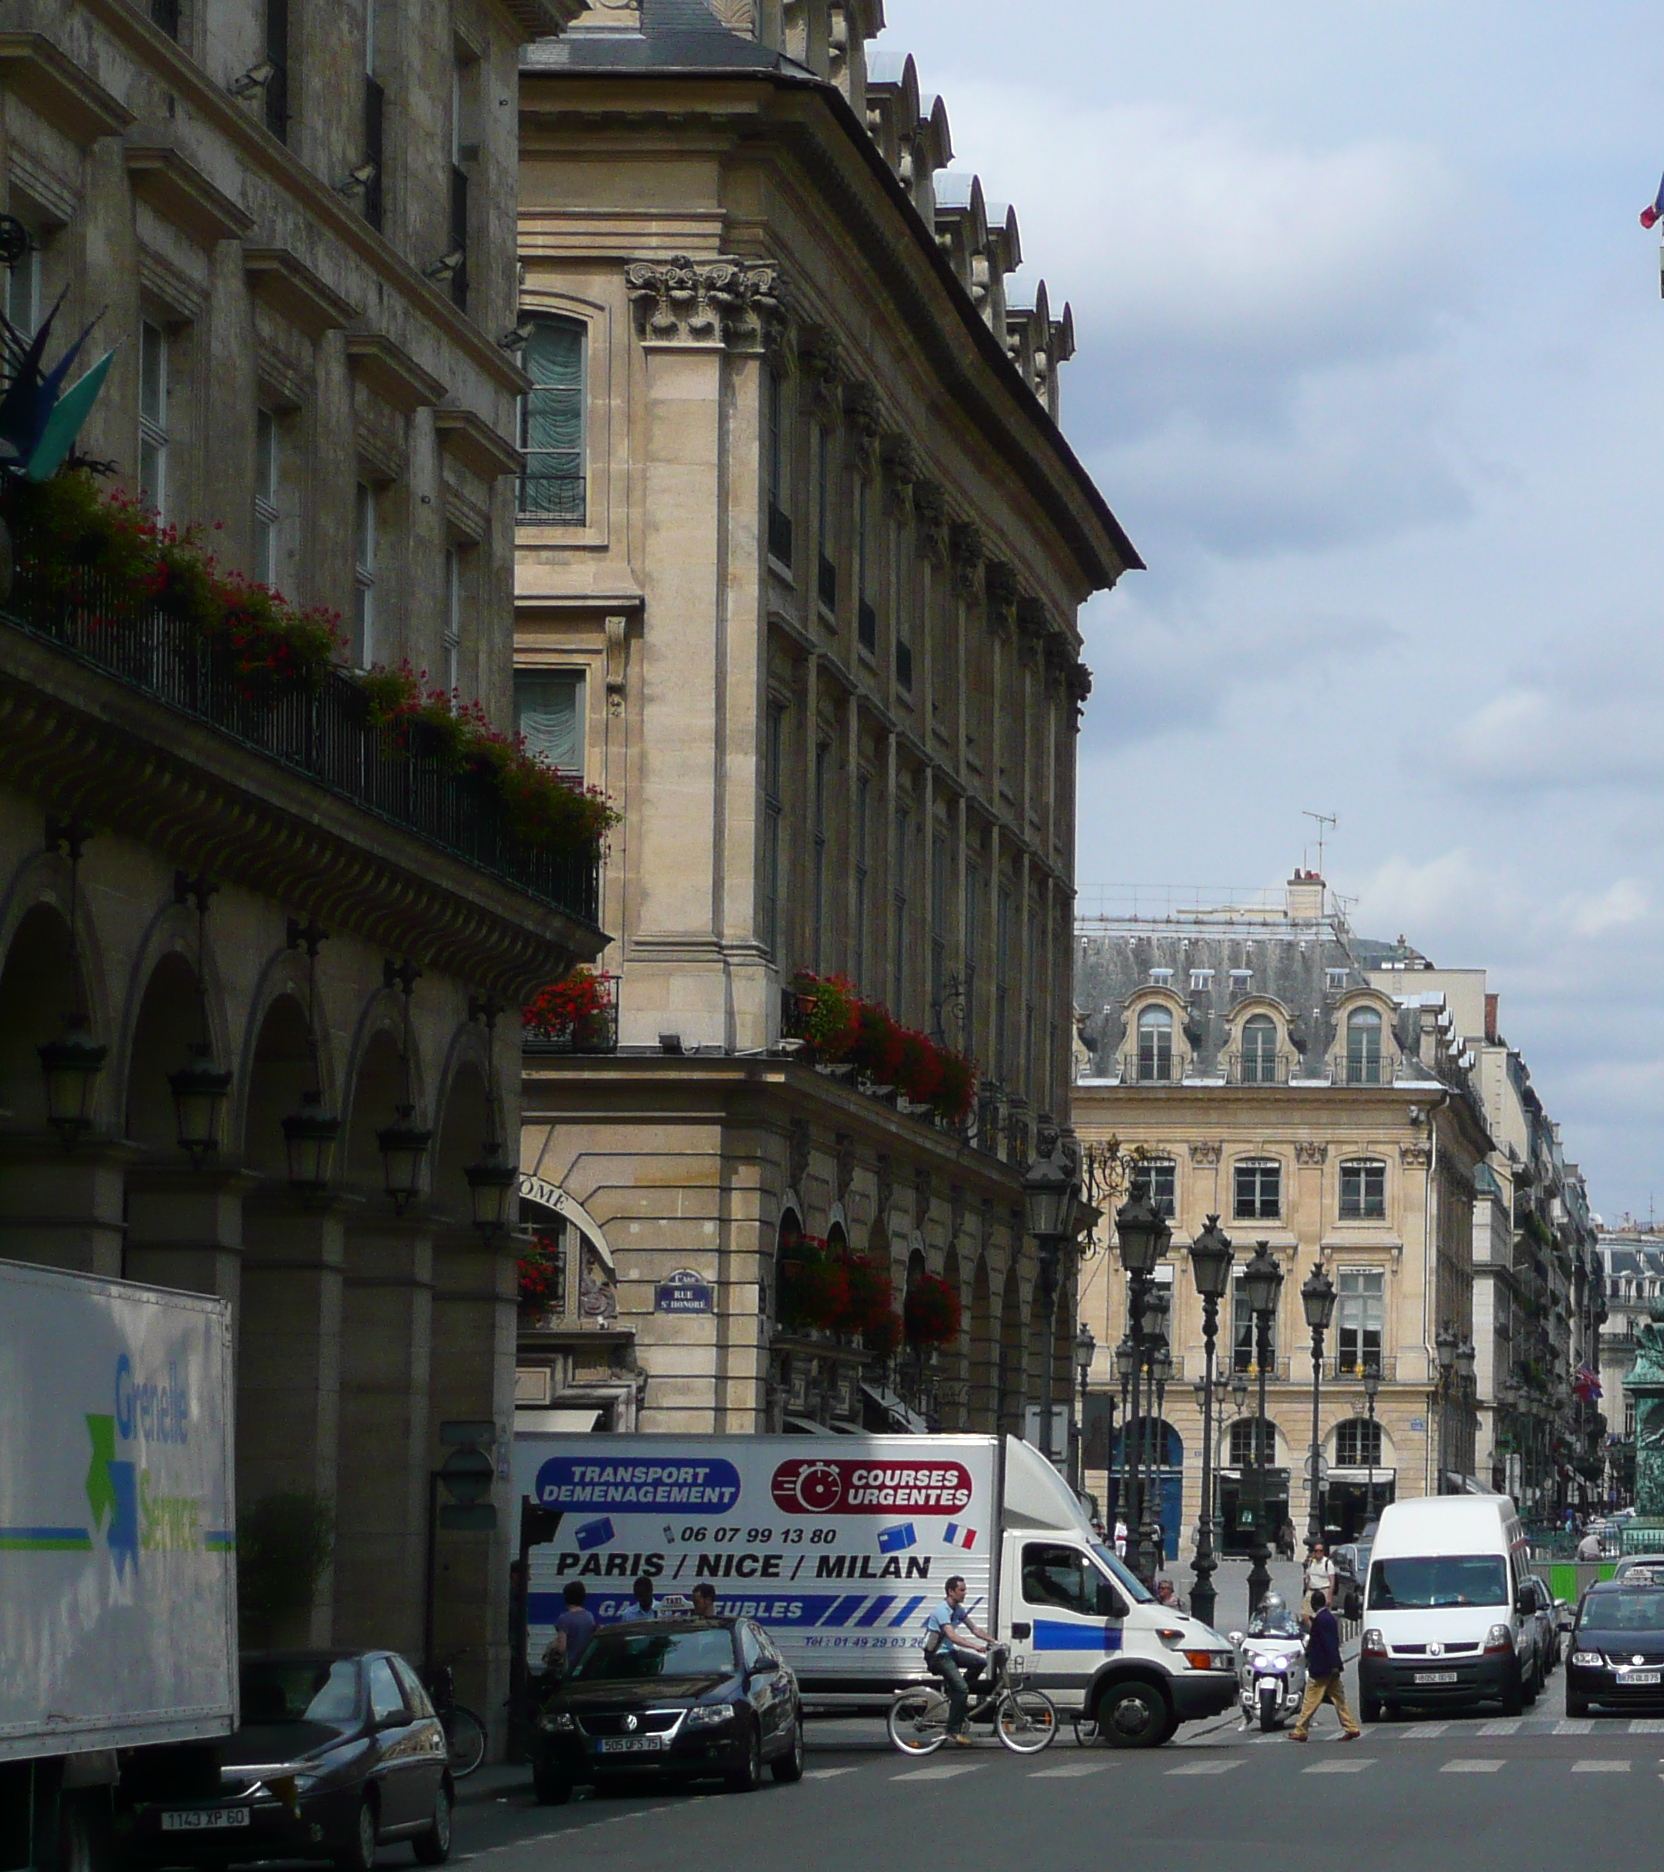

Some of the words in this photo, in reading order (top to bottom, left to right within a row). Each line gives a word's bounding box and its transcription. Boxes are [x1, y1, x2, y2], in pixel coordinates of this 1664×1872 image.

[674, 1290, 694, 1299] RUE
[671, 1300, 706, 1309] HONORÉ
[116, 1353, 188, 1444] Grenelle
[571, 1466, 710, 1483] TRANSPORT
[852, 1469, 959, 1486] COURSES
[542, 1485, 736, 1504] DEMENAGEMENT
[847, 1488, 969, 1506] URGENTES
[141, 1468, 199, 1550] Service
[680, 1526, 706, 1542] 06
[713, 1527, 741, 1542] 07
[746, 1527, 773, 1544] 99
[780, 1529, 803, 1544] 13
[809, 1529, 837, 1544] 80
[556, 1552, 665, 1577] PARIS
[672, 1554, 688, 1580] /
[695, 1553, 783, 1578] NICE
[790, 1555, 805, 1581] /
[815, 1555, 931, 1579] MILAN
[666, 1597, 682, 1605] TAXI
[834, 1637, 848, 1647] 01
[852, 1637, 868, 1647] 49
[872, 1638, 887, 1648] 29
[891, 1638, 906, 1648] 03
[604, 1739, 624, 1750] 505
[647, 1736, 659, 1748] 75
[206, 1810, 223, 1825] XP
[227, 1809, 245, 1824] 60
